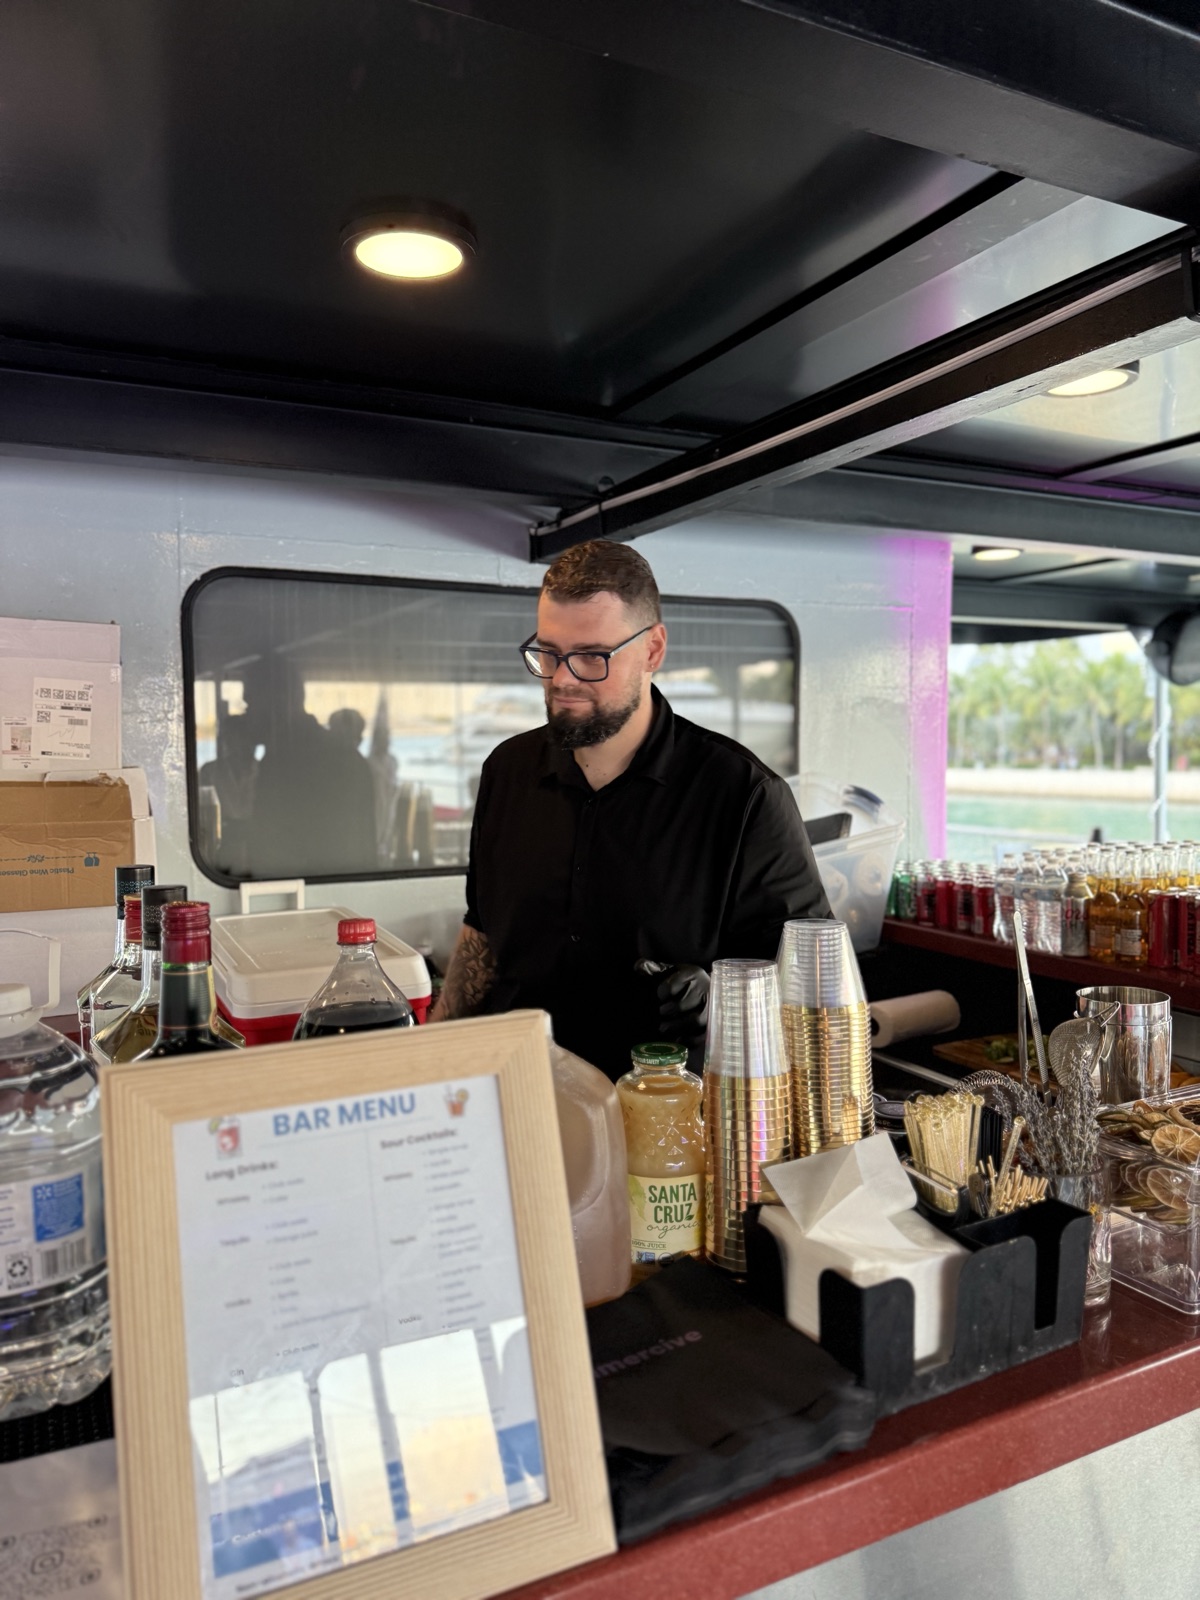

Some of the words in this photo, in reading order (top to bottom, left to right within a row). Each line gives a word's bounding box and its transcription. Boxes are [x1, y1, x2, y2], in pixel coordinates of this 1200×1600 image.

[272, 1107, 331, 1137] BAR
[337, 1092, 417, 1126] MENU
[648, 1182, 698, 1204] SANTA
[653, 1202, 694, 1224] CRUZ
[594, 1330, 702, 1379] mercive
